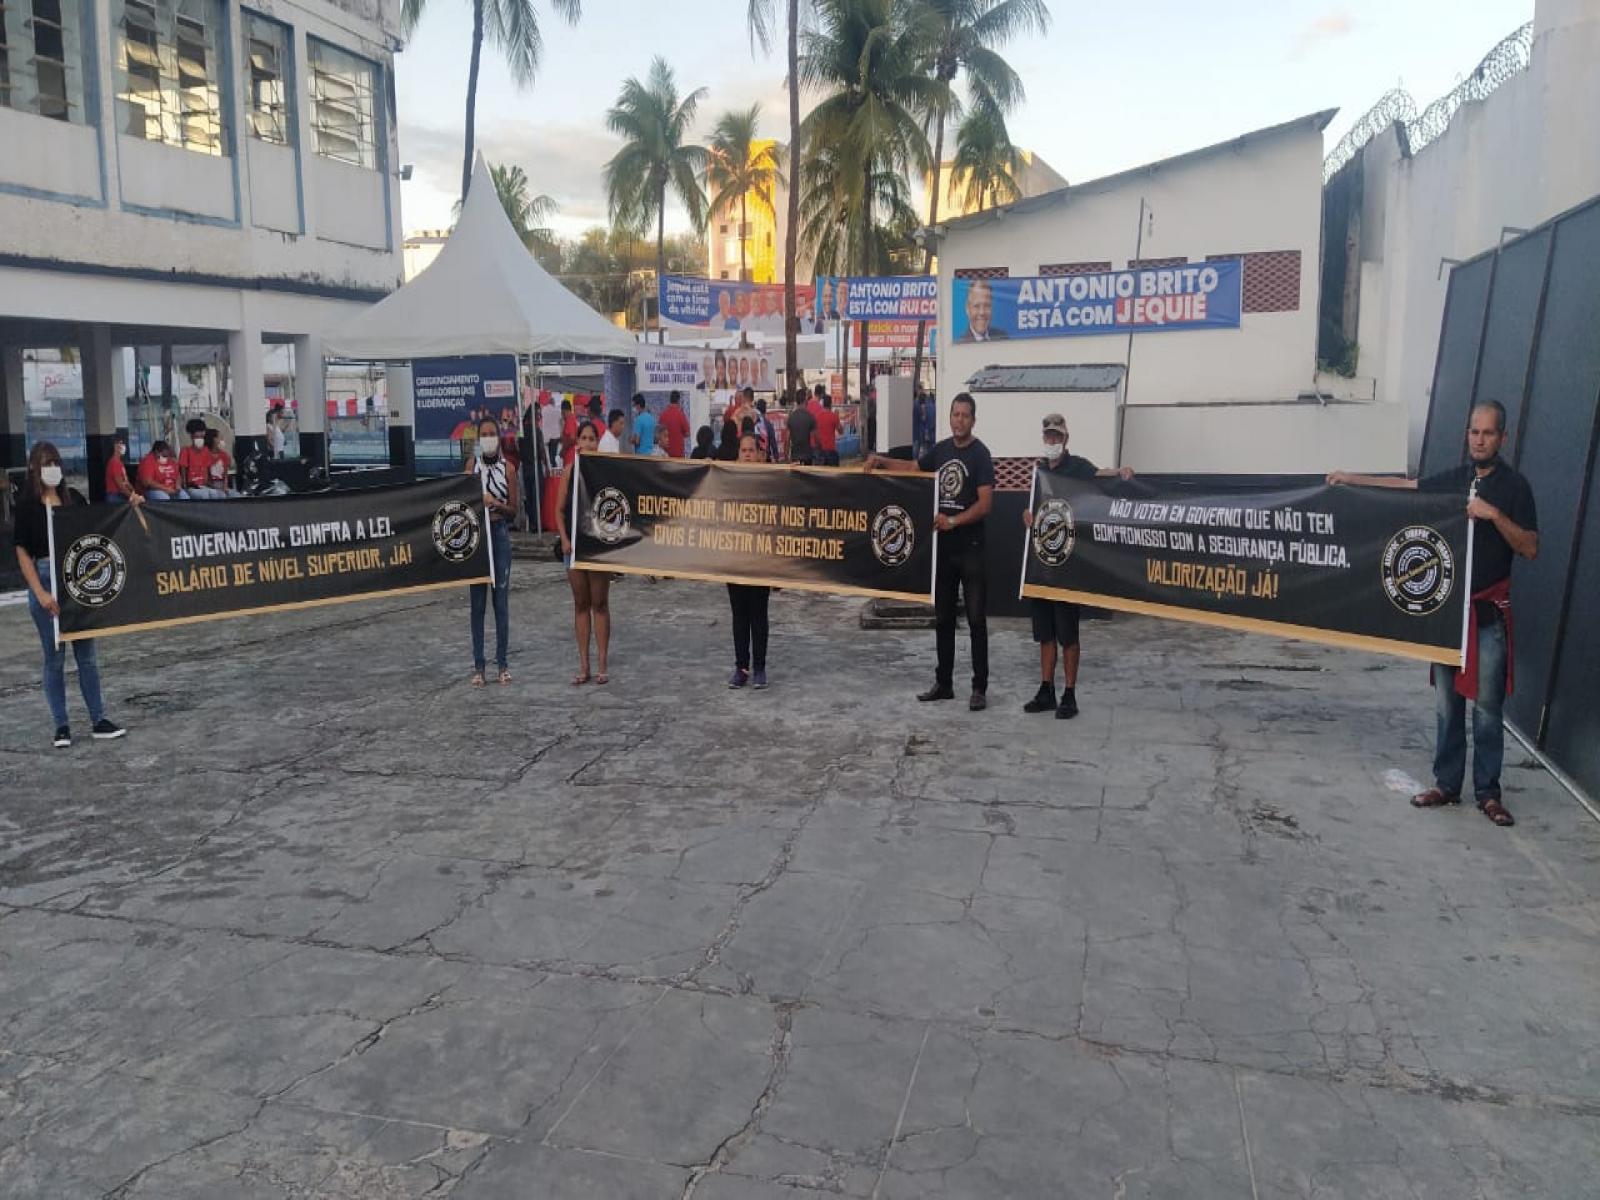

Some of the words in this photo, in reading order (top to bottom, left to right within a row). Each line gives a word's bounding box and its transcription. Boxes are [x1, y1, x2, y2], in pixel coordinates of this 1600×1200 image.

[849, 283, 900, 298] ANTONIO
[902, 282, 937, 297] BRITO
[1017, 274, 1134, 304] ANTONIO
[1140, 267, 1218, 296] BRITO
[849, 297, 872, 315] ESTÁ
[874, 300, 898, 315] COM
[900, 300, 920, 315] RUI
[1018, 301, 1064, 329] ESTÁ
[1066, 305, 1114, 326] COM
[1117, 292, 1206, 325] JEQUIÉ
[290, 520, 351, 546] CUMPRA
[356, 520, 366, 540] A
[723, 502, 777, 525] INVESTIR
[781, 506, 806, 527] NOS
[808, 508, 868, 532] POLICIAIS
[1109, 499, 1133, 518] NÃO
[1169, 505, 1186, 524] EM
[1186, 506, 1241, 528] GOVERNO
[1245, 508, 1271, 530] QUE
[1274, 506, 1302, 533] NÃO
[1306, 512, 1335, 535] TEM
[654, 524, 684, 547] CIVIS
[688, 528, 696, 547] E
[699, 528, 752, 552] INVESTIR
[757, 534, 772, 554] NA
[775, 535, 845, 560] SOCIEDADE
[1093, 523, 1167, 548] COMPROMISSO
[1169, 531, 1195, 551] COM
[1198, 534, 1206, 553] A
[1209, 535, 1286, 566] SEGURANÇA
[1289, 538, 1351, 568] PÚBLICA.
[156, 564, 227, 595] SALÁRIO
[232, 562, 256, 586] DE
[258, 557, 304, 582] NÍVEL
[389, 541, 412, 565] JÁ!
[1146, 558, 1247, 600] VALORIZAÇÃO
[1251, 568, 1280, 600] JÁ!
